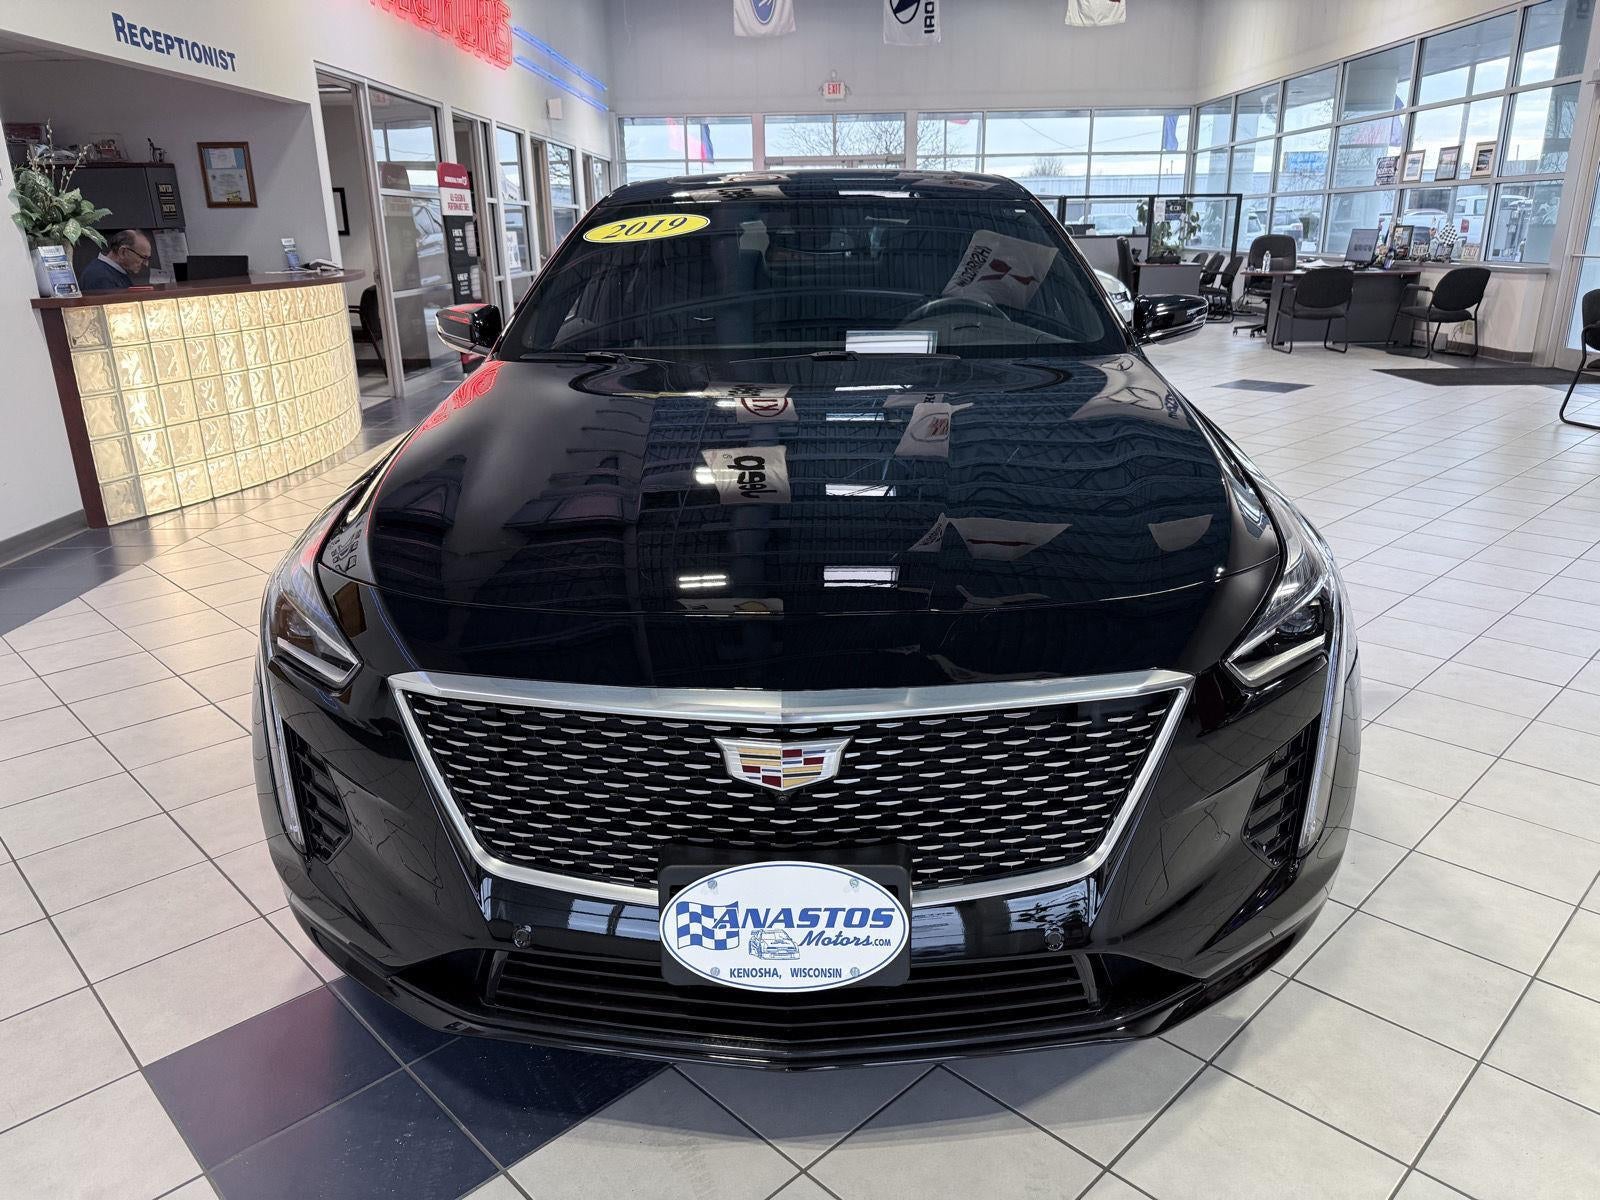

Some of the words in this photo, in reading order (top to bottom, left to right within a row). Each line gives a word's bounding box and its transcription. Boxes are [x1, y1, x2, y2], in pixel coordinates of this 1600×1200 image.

[112, 12, 236, 72] RECEPTIONIST
[828, 83, 841, 95] EXIT
[605, 216, 689, 240] 2019
[712, 906, 895, 929] ANASTOS
[729, 967, 782, 979] KENOSHA,
[790, 967, 842, 978] WISCONSIN
